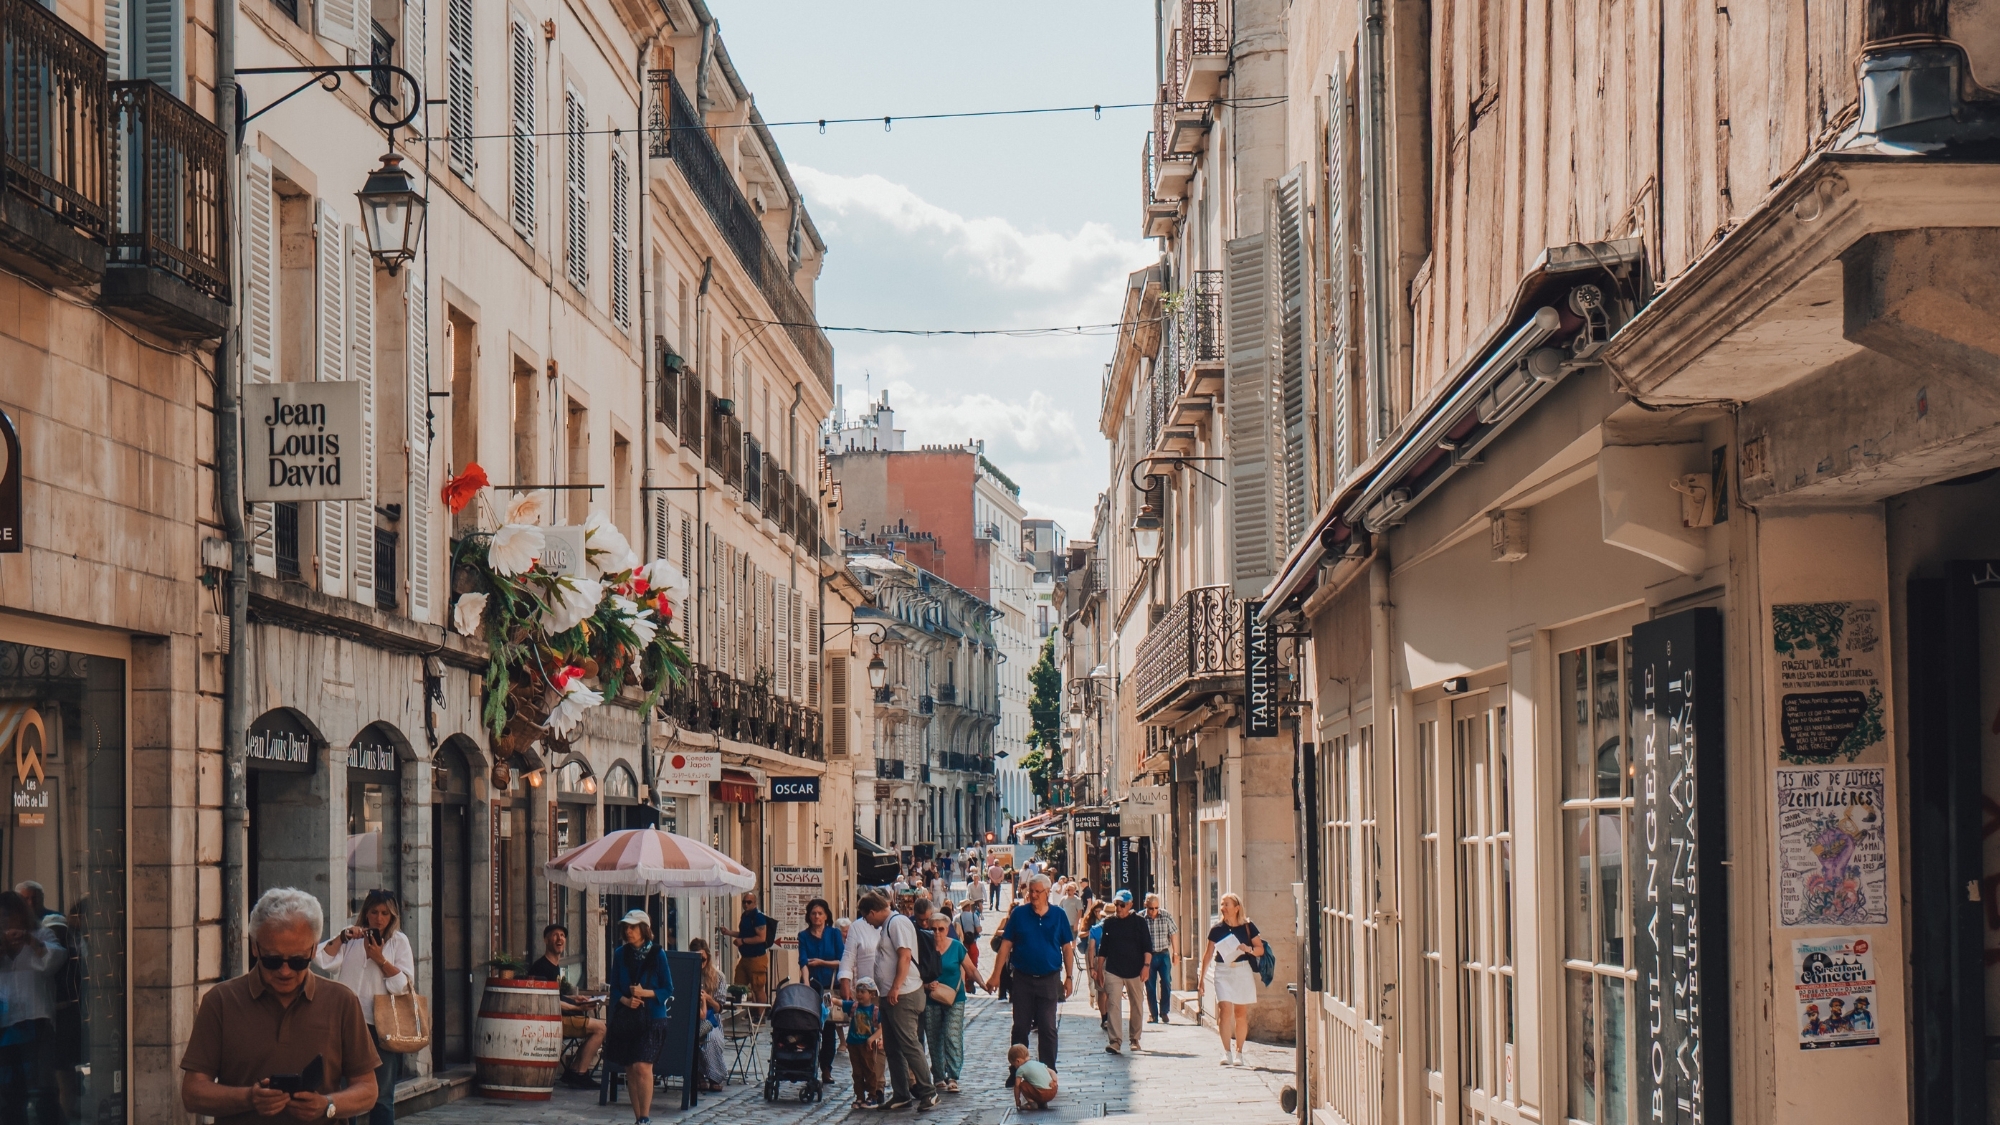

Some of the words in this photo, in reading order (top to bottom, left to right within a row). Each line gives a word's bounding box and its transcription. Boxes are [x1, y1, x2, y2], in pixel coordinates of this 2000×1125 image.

[265, 397, 325, 426] Jean
[269, 426, 339, 456] Louis
[269, 457, 341, 487] David
[1782, 658, 1852, 671] RASSEMBLEMENT
[266, 730, 286, 761] Louis
[288, 732, 309, 763] David
[359, 742, 376, 770] Louis
[377, 745, 394, 771] David
[690, 761, 711, 769] Japon
[27, 780, 36, 790] Les
[1783, 773, 1793, 787] 15
[1801, 773, 1819, 786] ANS
[1829, 773, 1840, 785] DE
[1845, 771, 1880, 786] LUTTES
[775, 783, 814, 795] OSCAR
[1788, 788, 1873, 807] LENTILLÈRES
[14, 791, 30, 807] toits
[31, 796, 38, 807] de
[39, 791, 49, 807] Lili
[775, 873, 820, 882] OSAKA
[1645, 663, 1664, 1123] BOULANGERIE
[1684, 668, 1701, 1125] TRAITEUR-SNACKING
[1801, 968, 1867, 984] Concert
